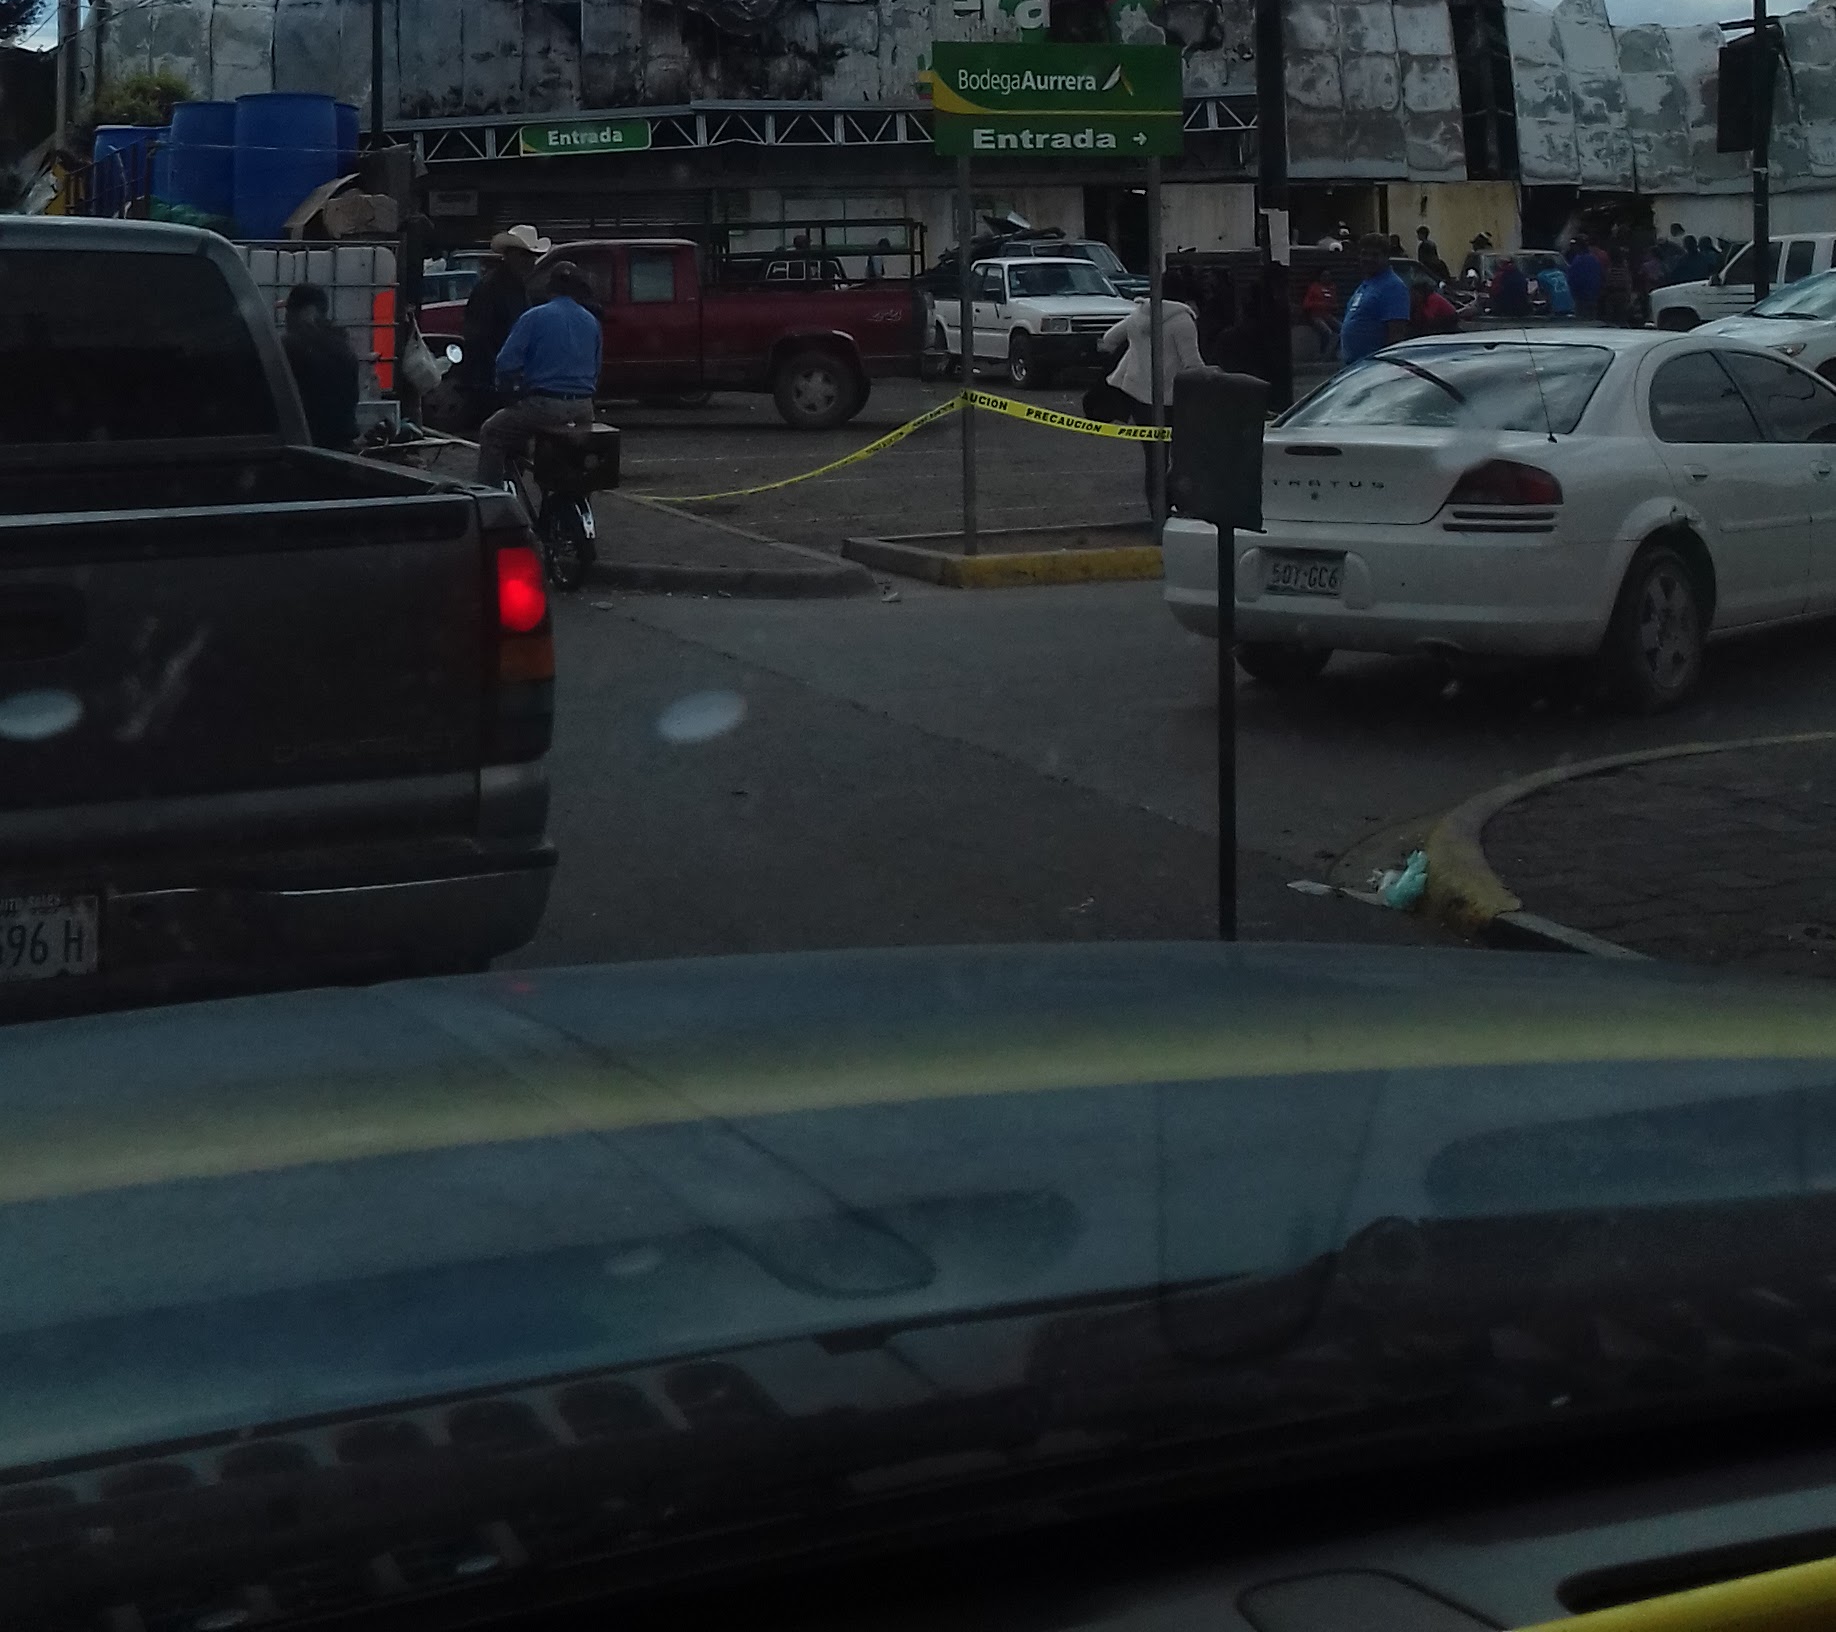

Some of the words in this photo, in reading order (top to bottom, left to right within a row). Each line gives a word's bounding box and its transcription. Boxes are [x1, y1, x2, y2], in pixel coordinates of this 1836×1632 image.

[547, 126, 624, 146] Entrada
[972, 128, 1117, 150] Entrada
[1117, 427, 1171, 439] PRECAUCI
[1271, 479, 1386, 489] TRATUS
[0, 921, 49, 967] 96
